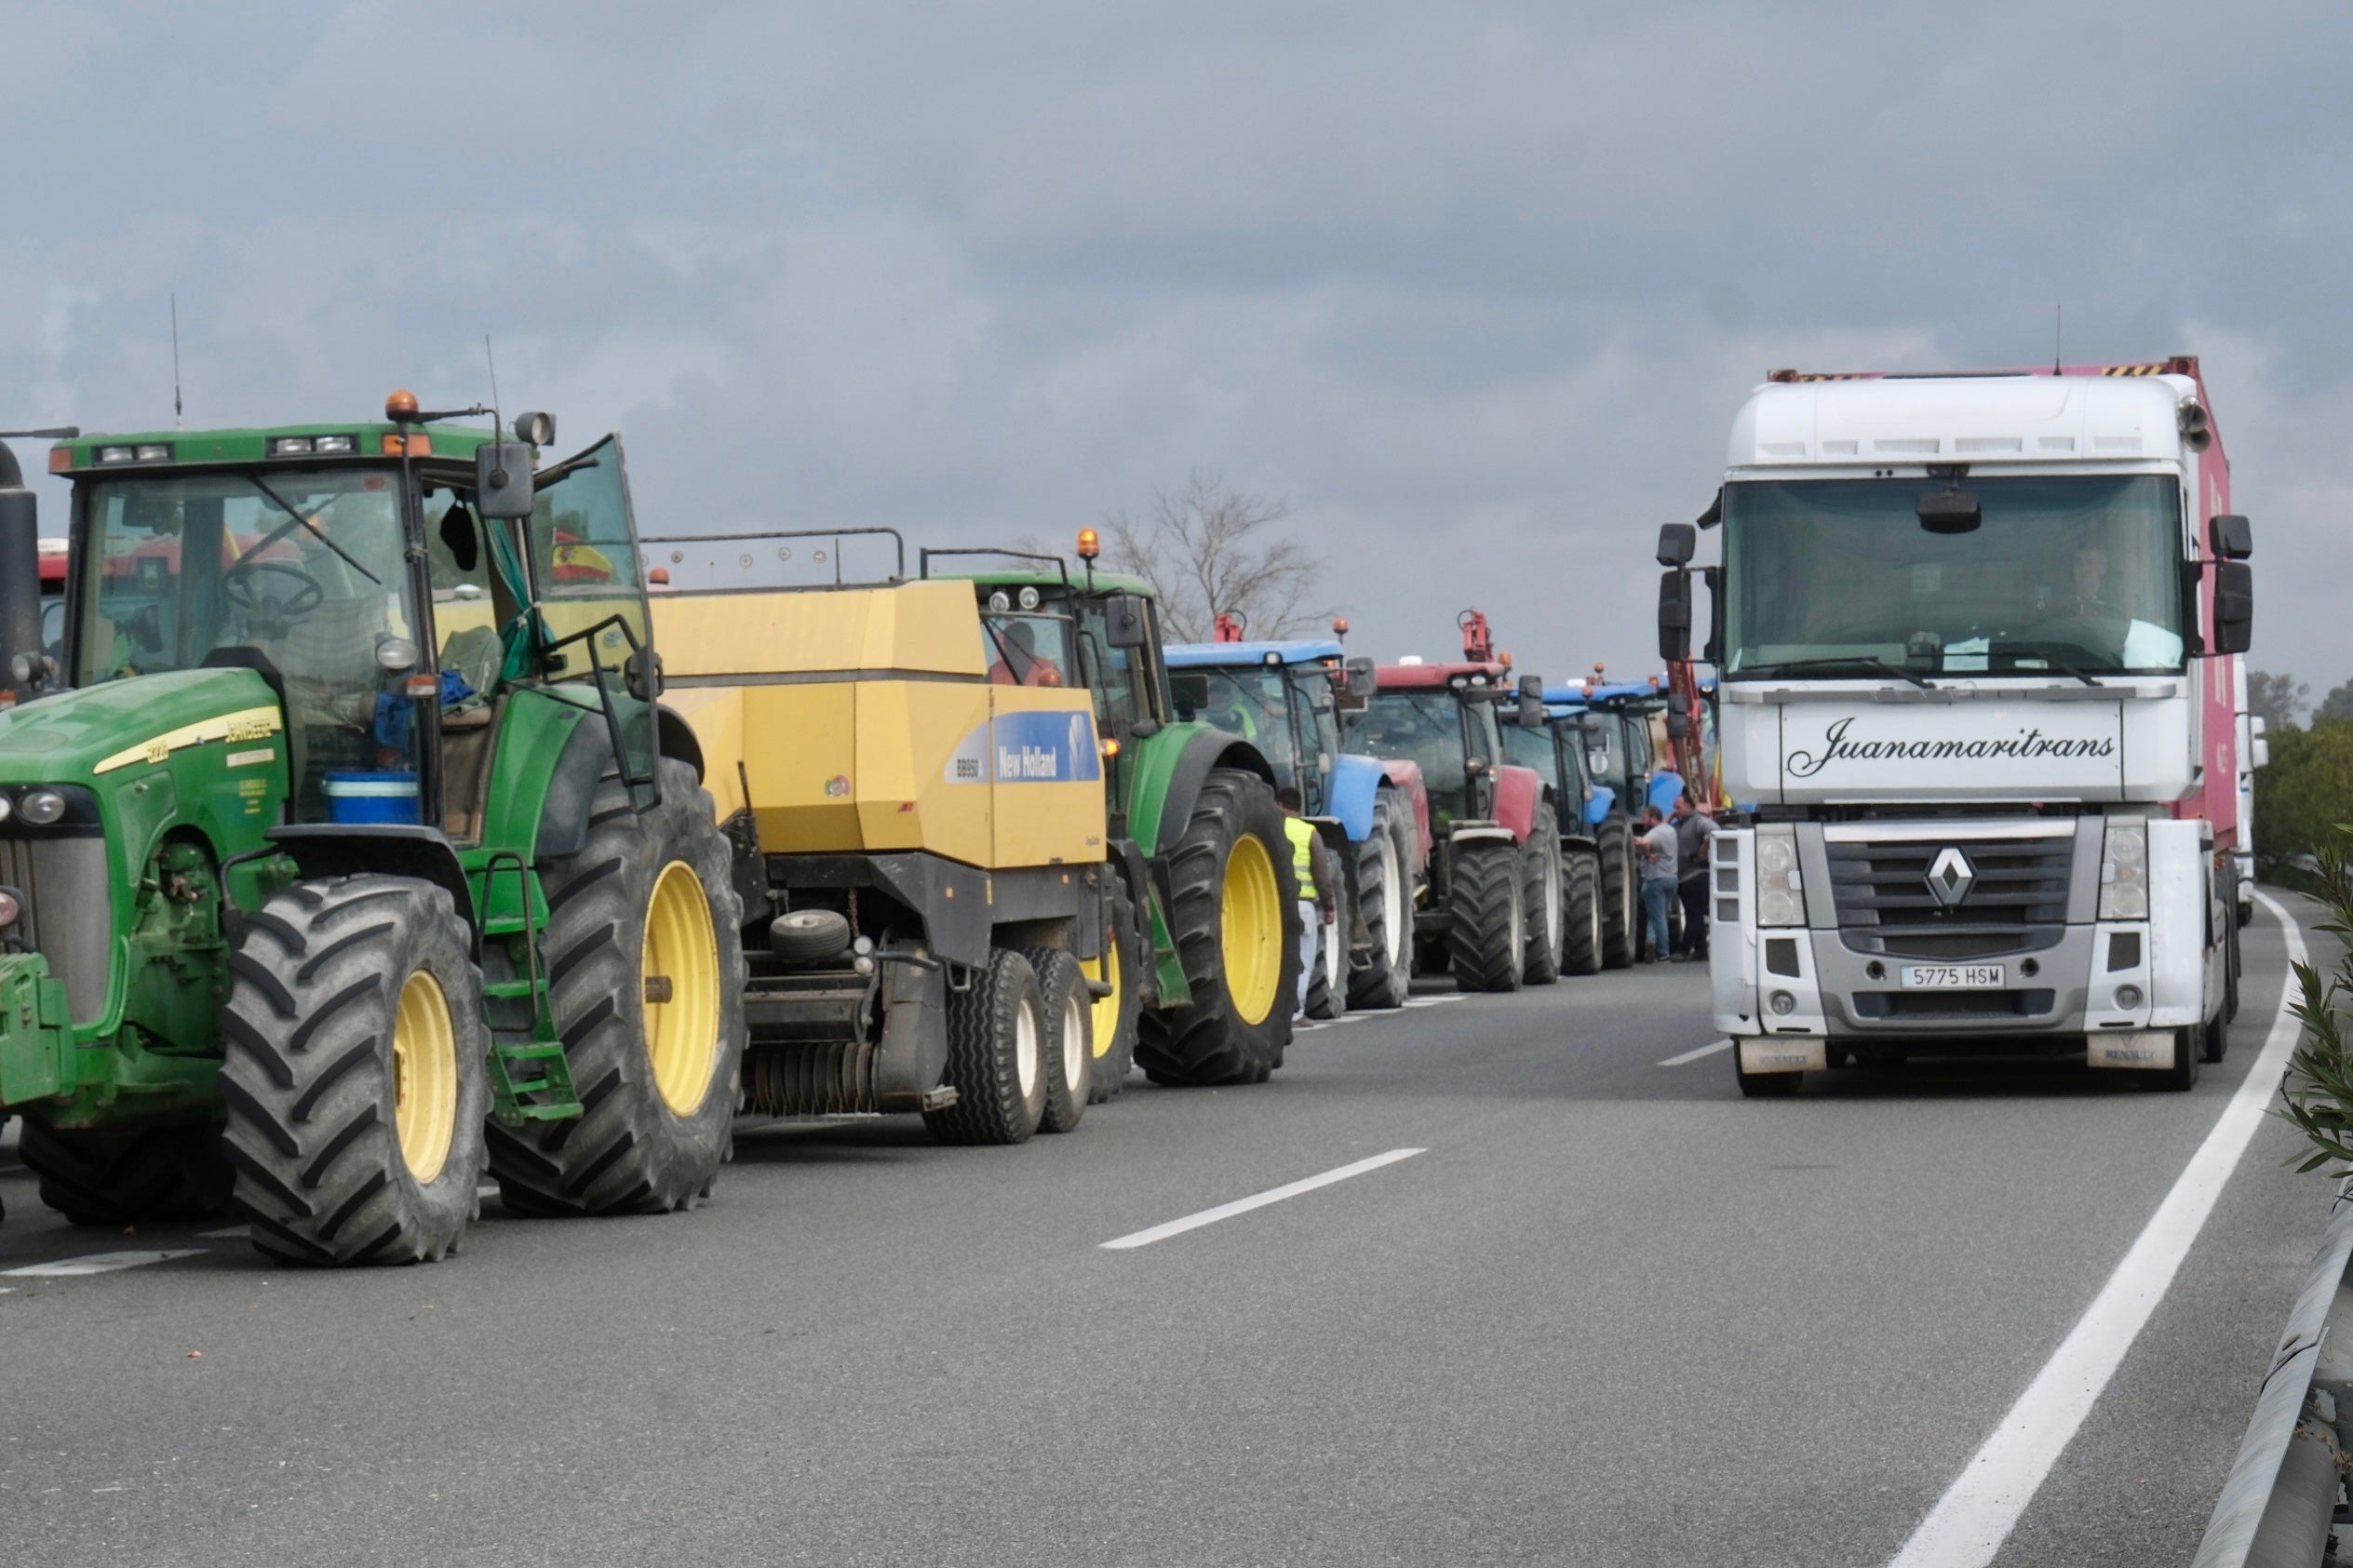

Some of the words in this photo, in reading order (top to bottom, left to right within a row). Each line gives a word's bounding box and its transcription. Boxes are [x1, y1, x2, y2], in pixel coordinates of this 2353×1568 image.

[999, 745, 1021, 778] New
[1023, 745, 1057, 777] Holland
[1787, 717, 2115, 777] Juanamaritrans
[1914, 969, 1959, 985] 5775
[1966, 968, 1999, 985] HSM
